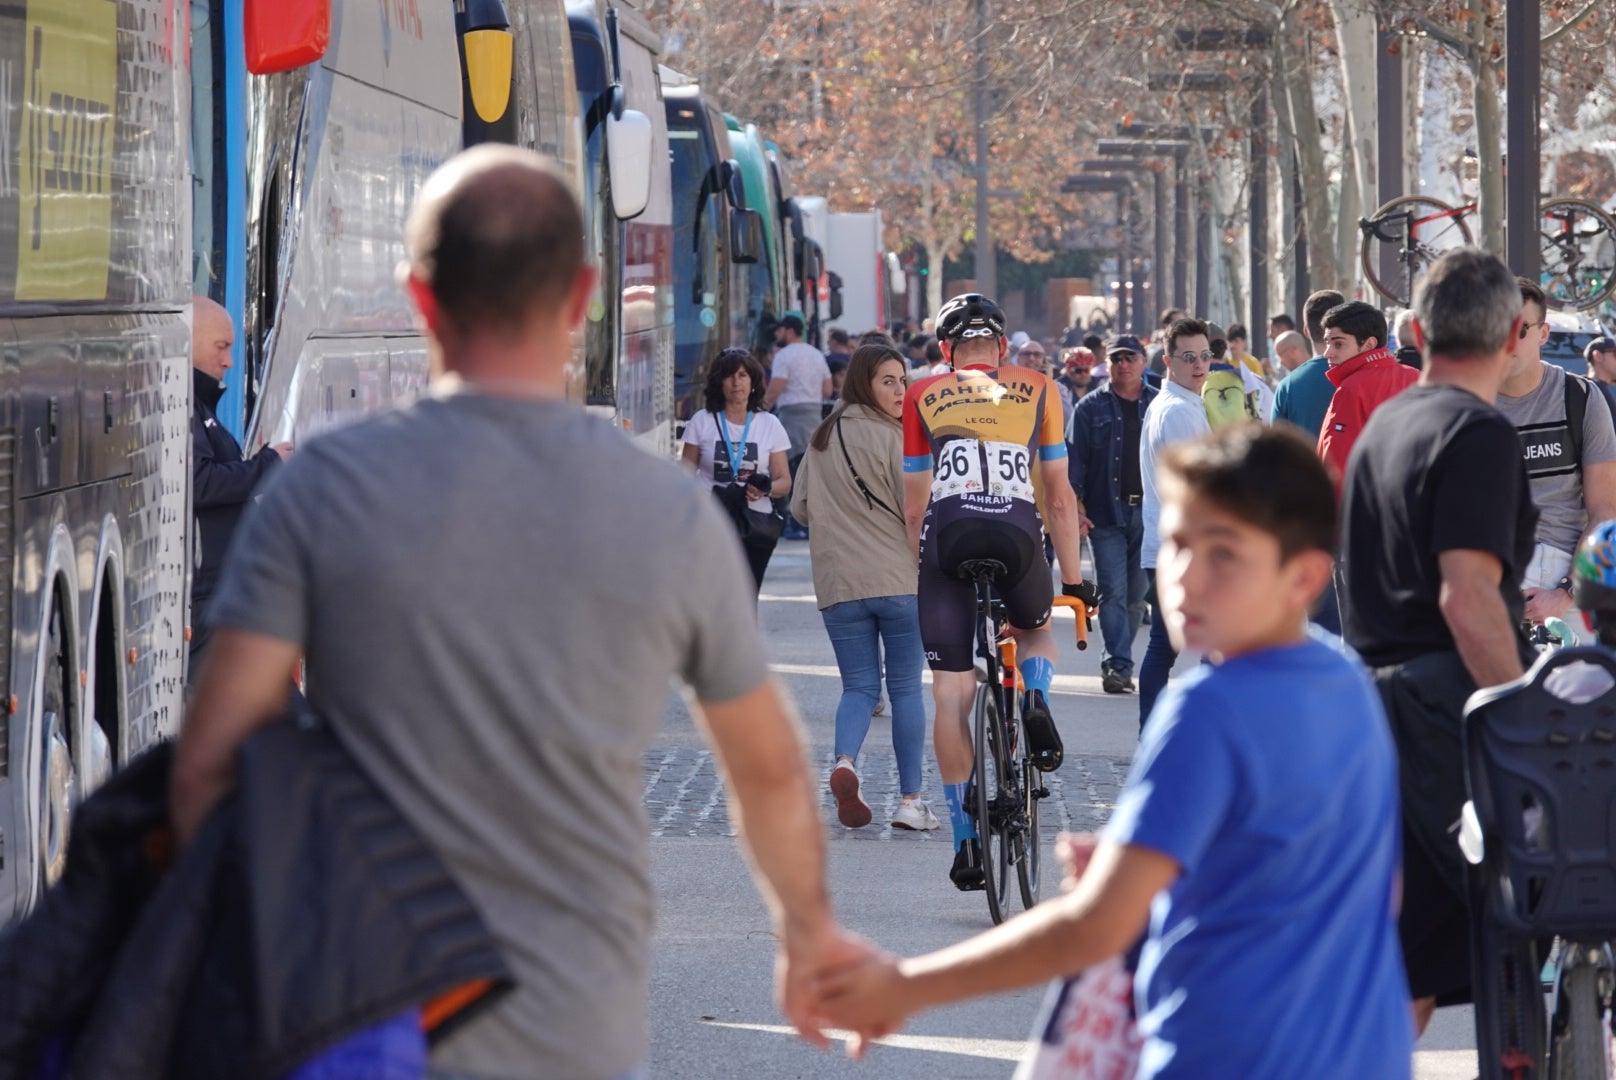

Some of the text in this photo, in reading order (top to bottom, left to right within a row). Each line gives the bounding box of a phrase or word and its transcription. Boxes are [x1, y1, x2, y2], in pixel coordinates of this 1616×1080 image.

[940, 445, 969, 482] 56
[1523, 442, 1562, 460] JEANS
[999, 449, 1027, 484] 56
[960, 491, 1013, 505] BAHRAIN
